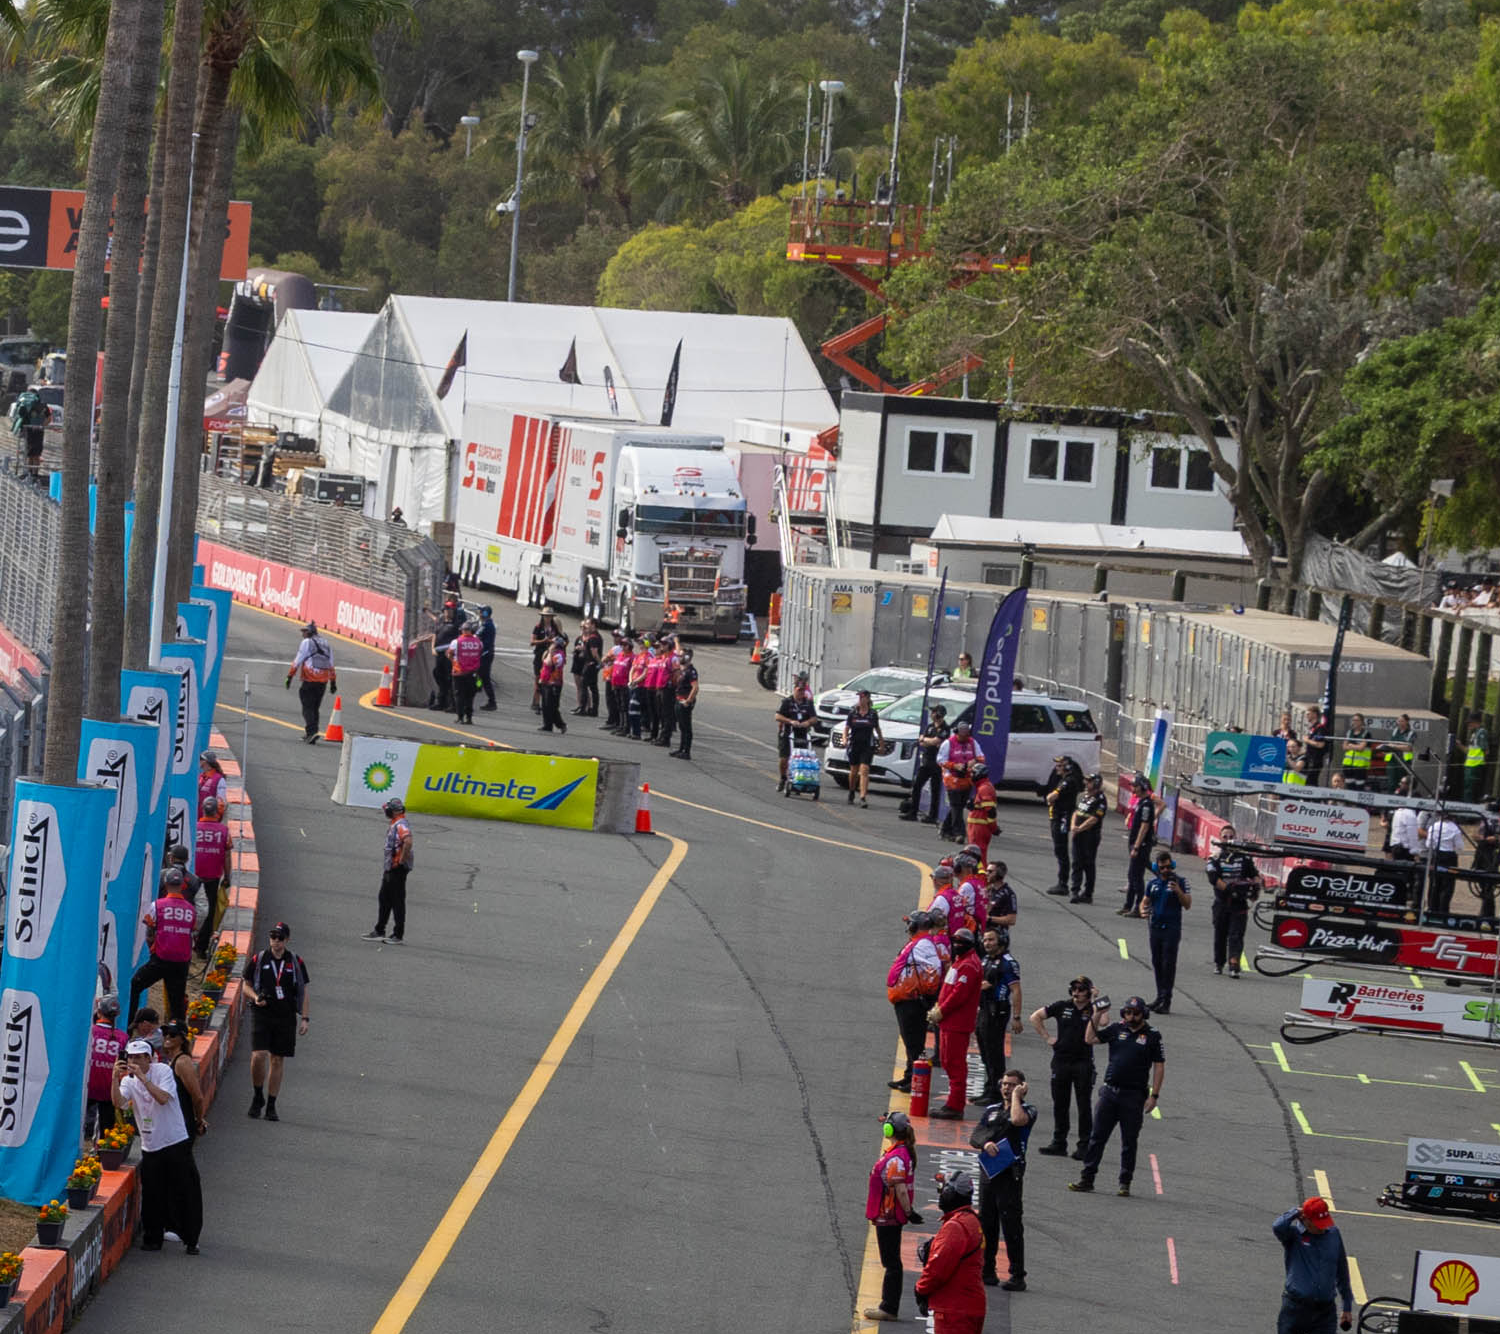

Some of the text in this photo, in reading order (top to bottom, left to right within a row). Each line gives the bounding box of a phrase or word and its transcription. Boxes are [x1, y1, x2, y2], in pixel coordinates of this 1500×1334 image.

[834, 585, 853, 594] AMA
[384, 749, 399, 762] bp
[424, 770, 538, 804] ultimate
[1282, 823, 1317, 834] ISUZU
[1326, 830, 1361, 841] NULON
[196, 831, 223, 844] 251
[1301, 873, 1397, 898] erebus
[163, 906, 194, 922] 296
[1310, 926, 1393, 955] Pizza Hut
[1357, 984, 1426, 1003] Batteries
[90, 1037, 121, 1057] 83
